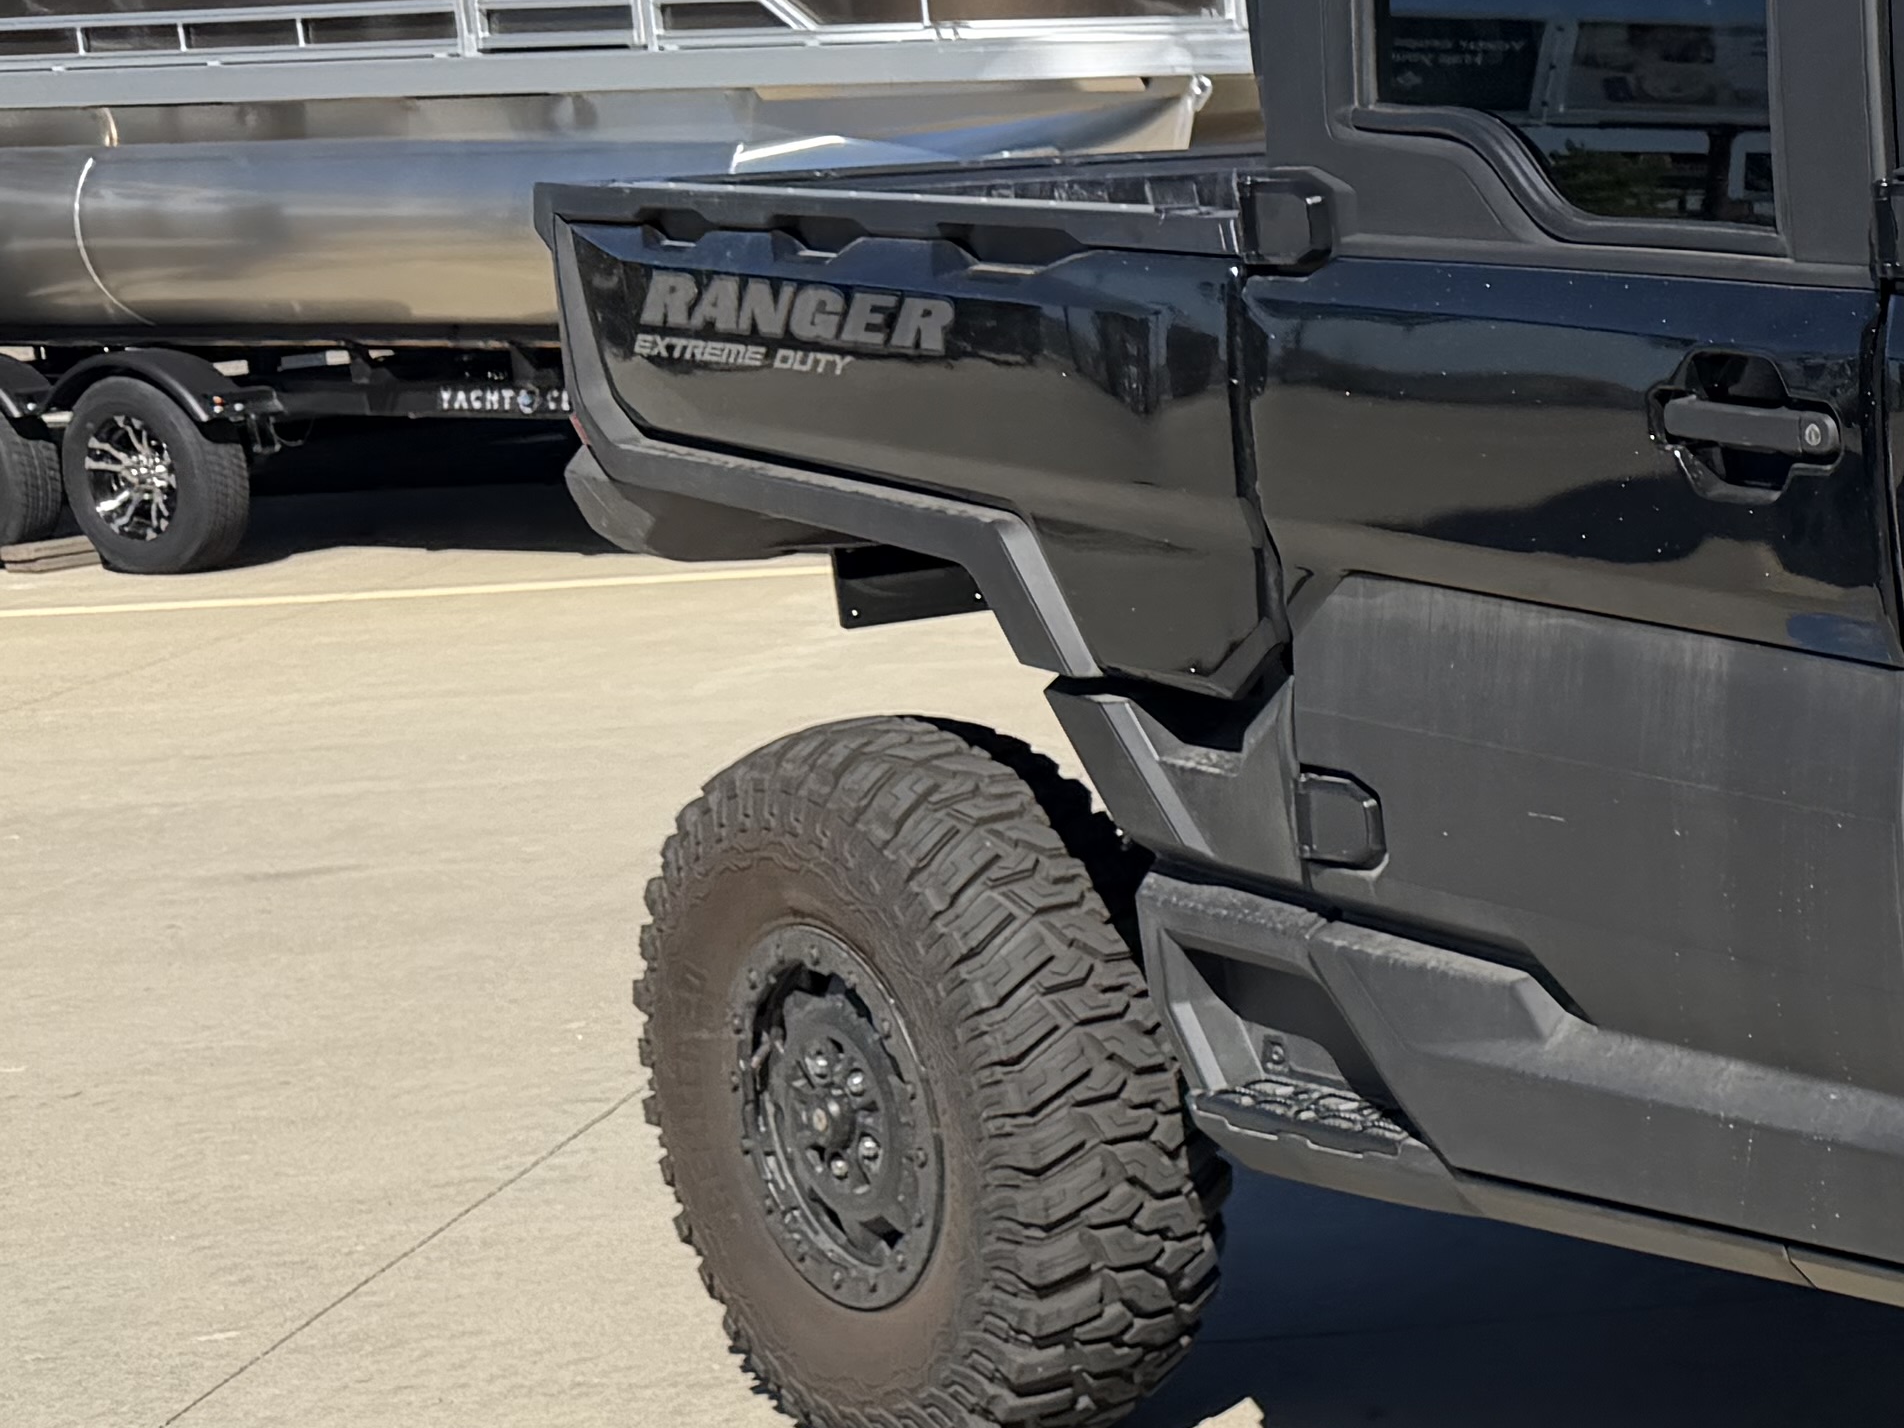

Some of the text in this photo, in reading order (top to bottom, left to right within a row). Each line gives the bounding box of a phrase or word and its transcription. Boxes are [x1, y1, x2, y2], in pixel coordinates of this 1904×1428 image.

[639, 269, 956, 356] RANGER
[633, 333, 853, 375] EXTREME DUTY
[440, 386, 515, 411] YACHT
